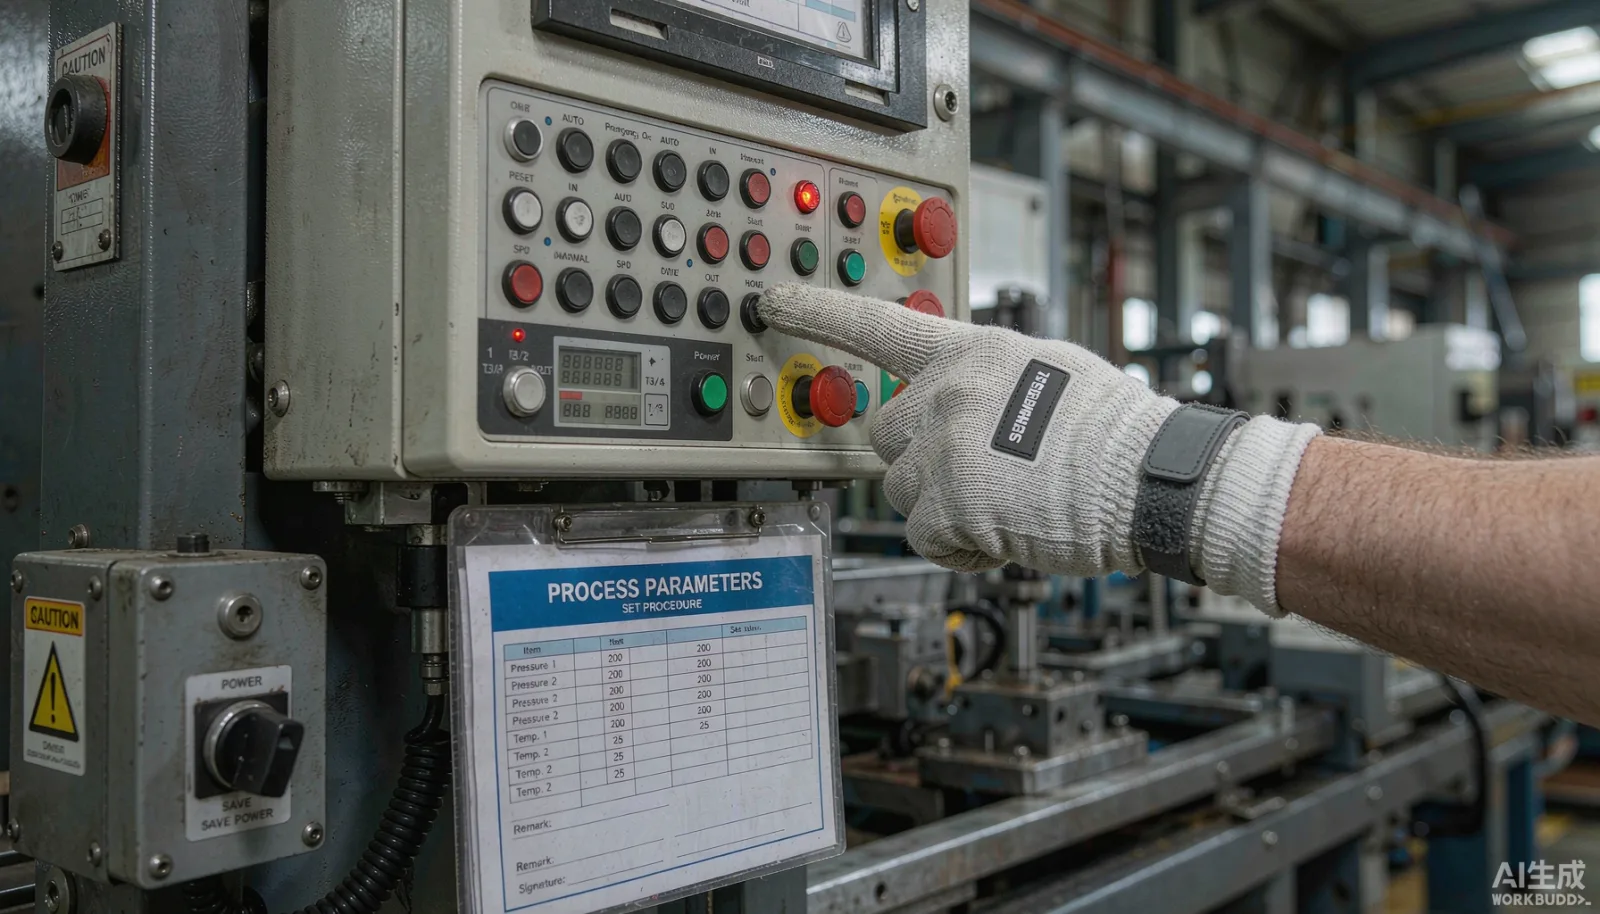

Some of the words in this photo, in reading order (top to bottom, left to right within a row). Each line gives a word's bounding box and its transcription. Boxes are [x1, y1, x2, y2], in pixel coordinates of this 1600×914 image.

[62, 46, 106, 76] CAUTION
[562, 113, 585, 126] AUTO
[660, 136, 680, 147] AUTO
[709, 147, 717, 155] IN
[568, 183, 579, 192] IN
[704, 273, 720, 283] OUT
[547, 578, 640, 603] PROCESS
[645, 571, 763, 597] PARAMETERS
[622, 602, 641, 614] SET
[643, 599, 703, 612] PROCEDURE
[30, 605, 79, 630] CAUTION
[523, 646, 542, 655] Item
[697, 643, 711, 653] 200
[608, 653, 623, 663] 200
[697, 659, 711, 668] 200
[510, 662, 549, 673] Pressure
[552, 660, 556, 669] 1
[608, 669, 623, 680] 200
[697, 675, 711, 684] 200
[221, 676, 263, 690] POWER
[511, 679, 549, 690] Pressure
[552, 677, 557, 686] 2
[609, 685, 624, 696] 200
[697, 690, 712, 699] 200
[512, 696, 549, 708] Pressure
[552, 694, 558, 703] 2
[609, 702, 625, 712] 200
[697, 706, 711, 715] 200
[512, 713, 550, 725] Pressure
[553, 711, 559, 720] 2
[610, 718, 625, 729] 200
[699, 721, 710, 730] 25
[513, 733, 540, 744] Temp.
[543, 731, 547, 739] 1
[613, 735, 624, 745] 25
[514, 750, 541, 761] Temp.
[544, 748, 549, 757] 2
[613, 752, 624, 761] 25
[516, 768, 544, 779] Temp.
[546, 765, 552, 774] 2
[614, 768, 625, 778] 25
[516, 786, 544, 797] Temp.
[546, 783, 552, 792] 2
[222, 797, 252, 812] SAVE
[201, 816, 231, 831] SAVE
[234, 808, 274, 825] POWER
[513, 820, 552, 835] Remark:
[518, 876, 566, 895] Signature:
